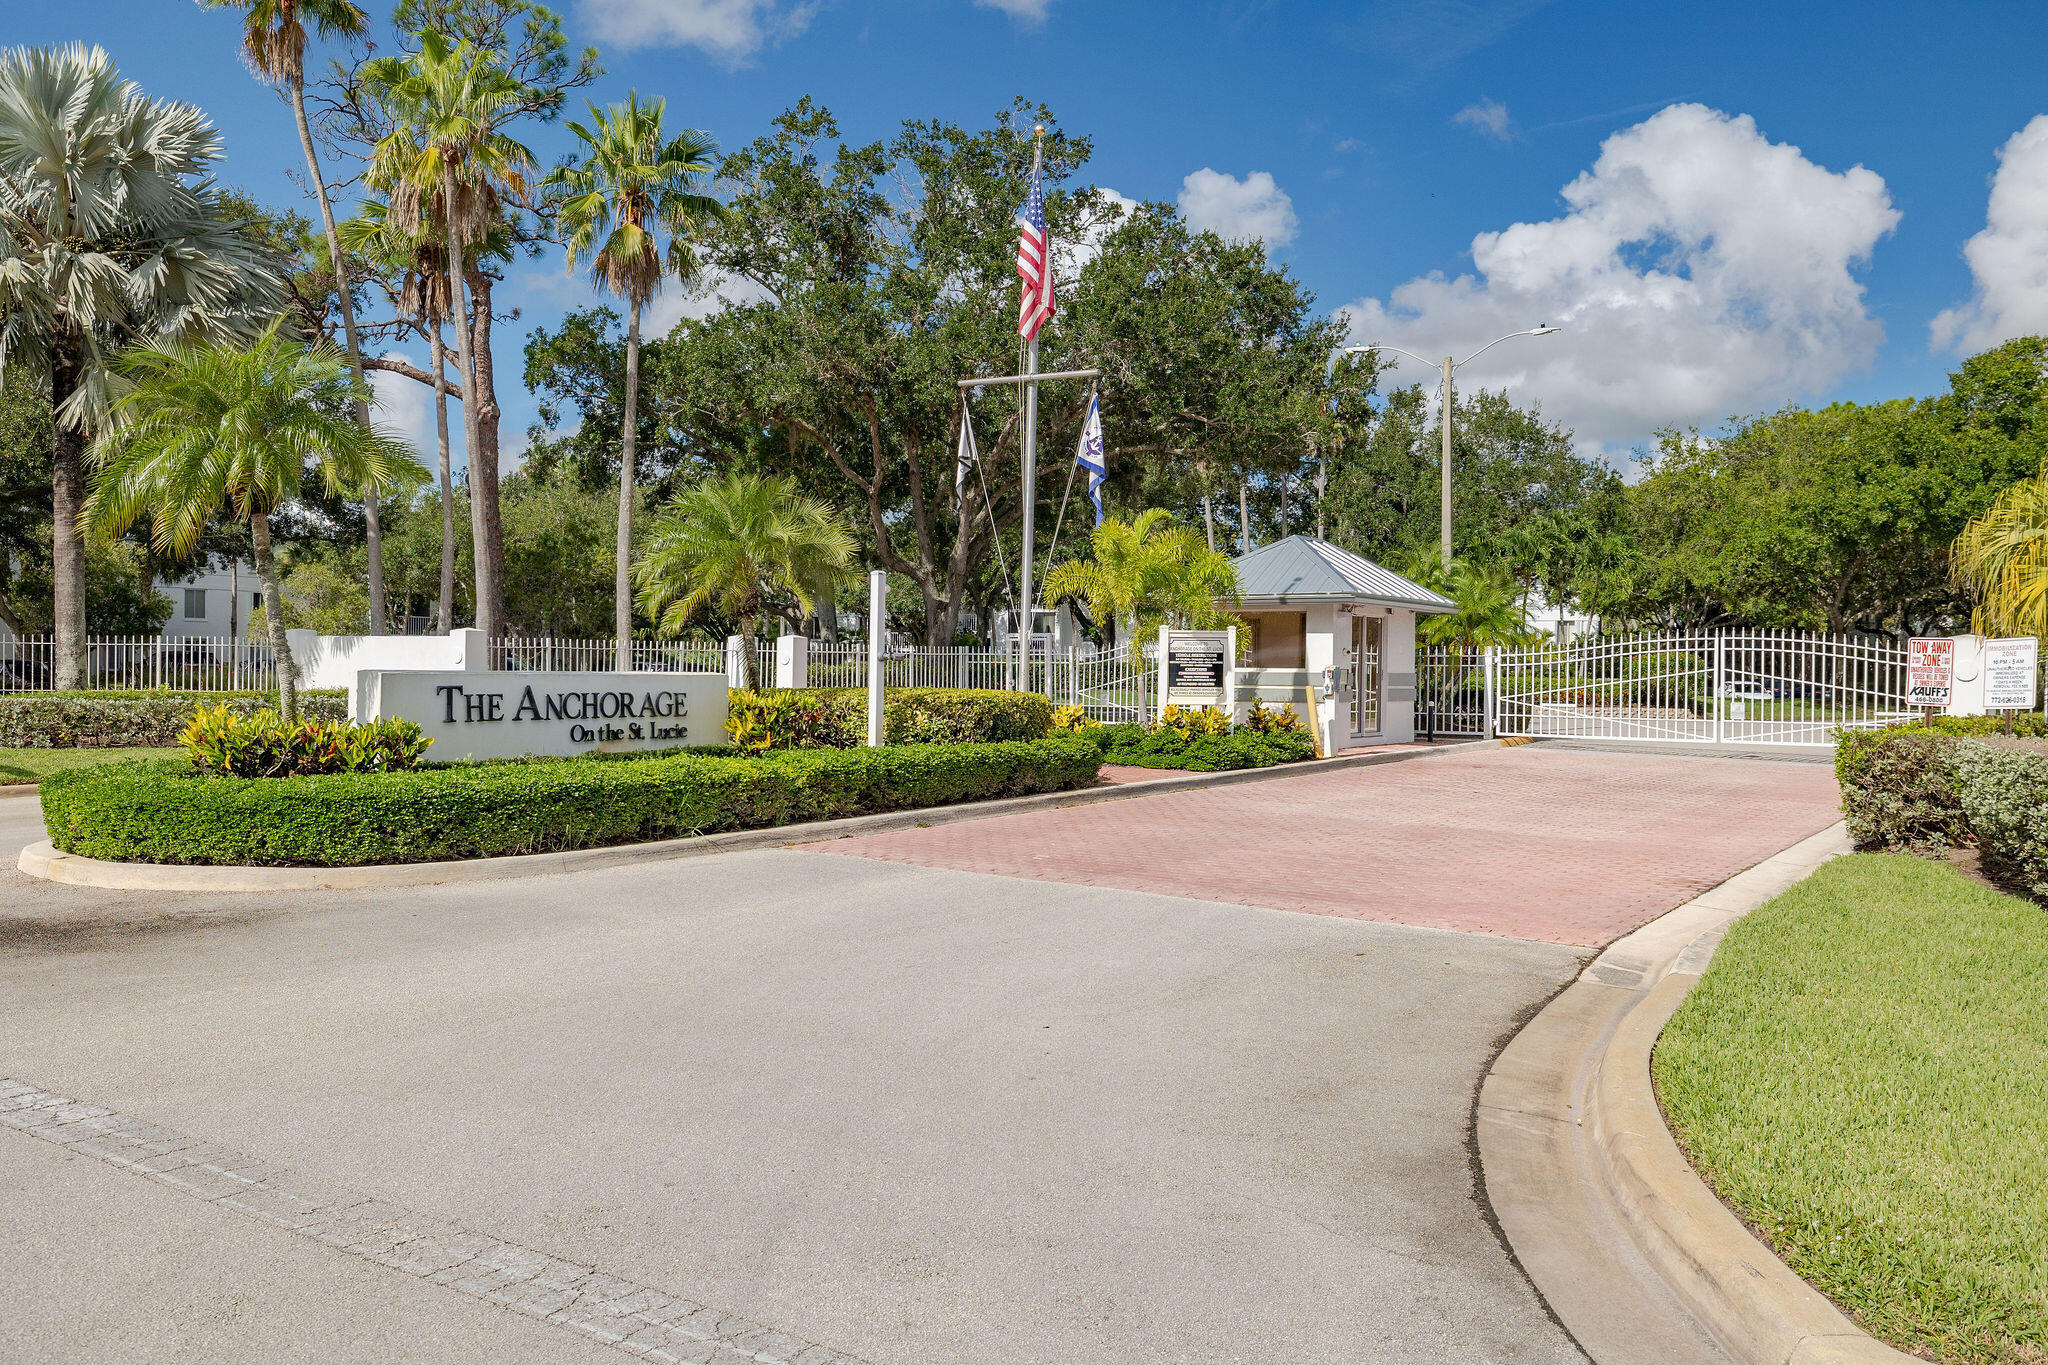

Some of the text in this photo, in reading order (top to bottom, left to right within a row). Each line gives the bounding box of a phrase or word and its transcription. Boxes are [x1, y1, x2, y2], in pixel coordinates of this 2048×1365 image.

[1912, 641, 1952, 654] TOW AWAY
[1987, 644, 2032, 652] IMMOBILIZATION
[1922, 654, 1941, 666] ZONE
[1909, 686, 1950, 697] KAUFF'S
[436, 685, 688, 722] THE ANCHORAGE
[570, 722, 688, 742] On the St. Lucie
